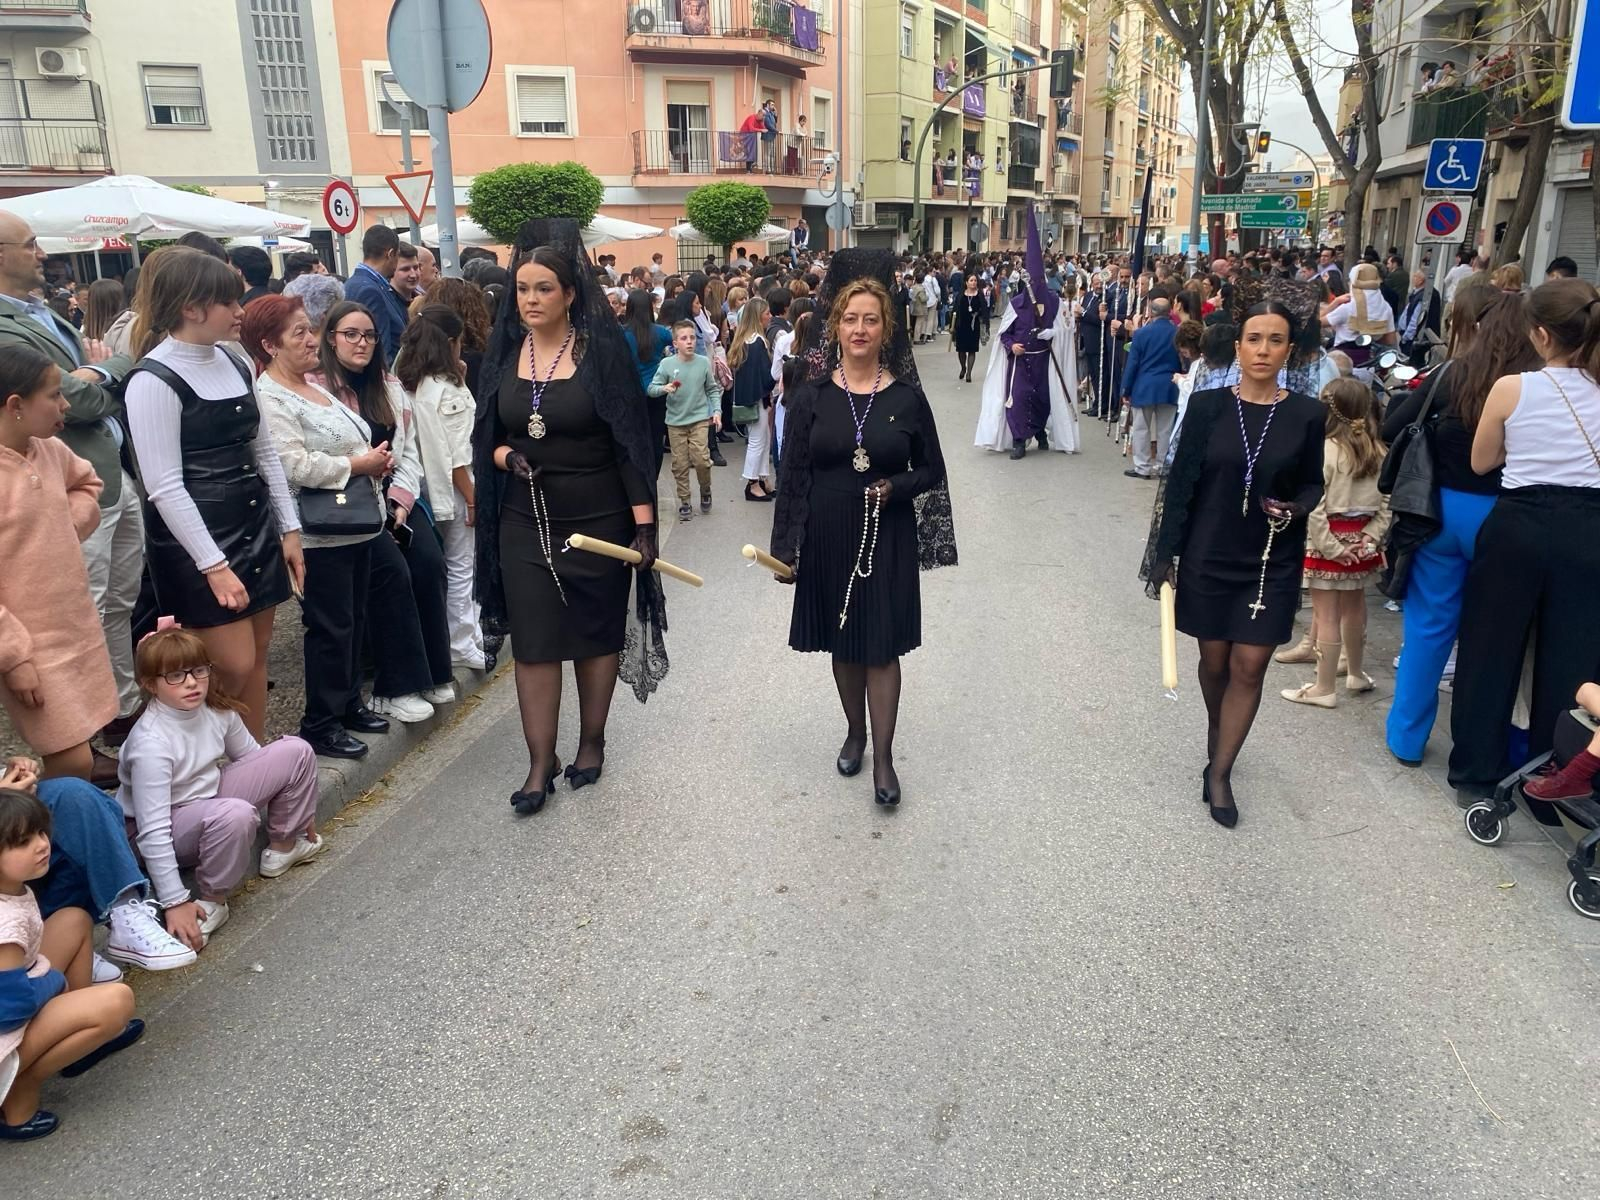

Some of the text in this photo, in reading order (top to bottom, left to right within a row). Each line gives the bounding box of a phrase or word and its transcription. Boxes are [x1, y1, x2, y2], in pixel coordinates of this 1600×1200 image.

[1201, 196, 1262, 204] Avenida de Granada
[334, 198, 343, 217] 6
[83, 214, 129, 226] Cruzcampo
